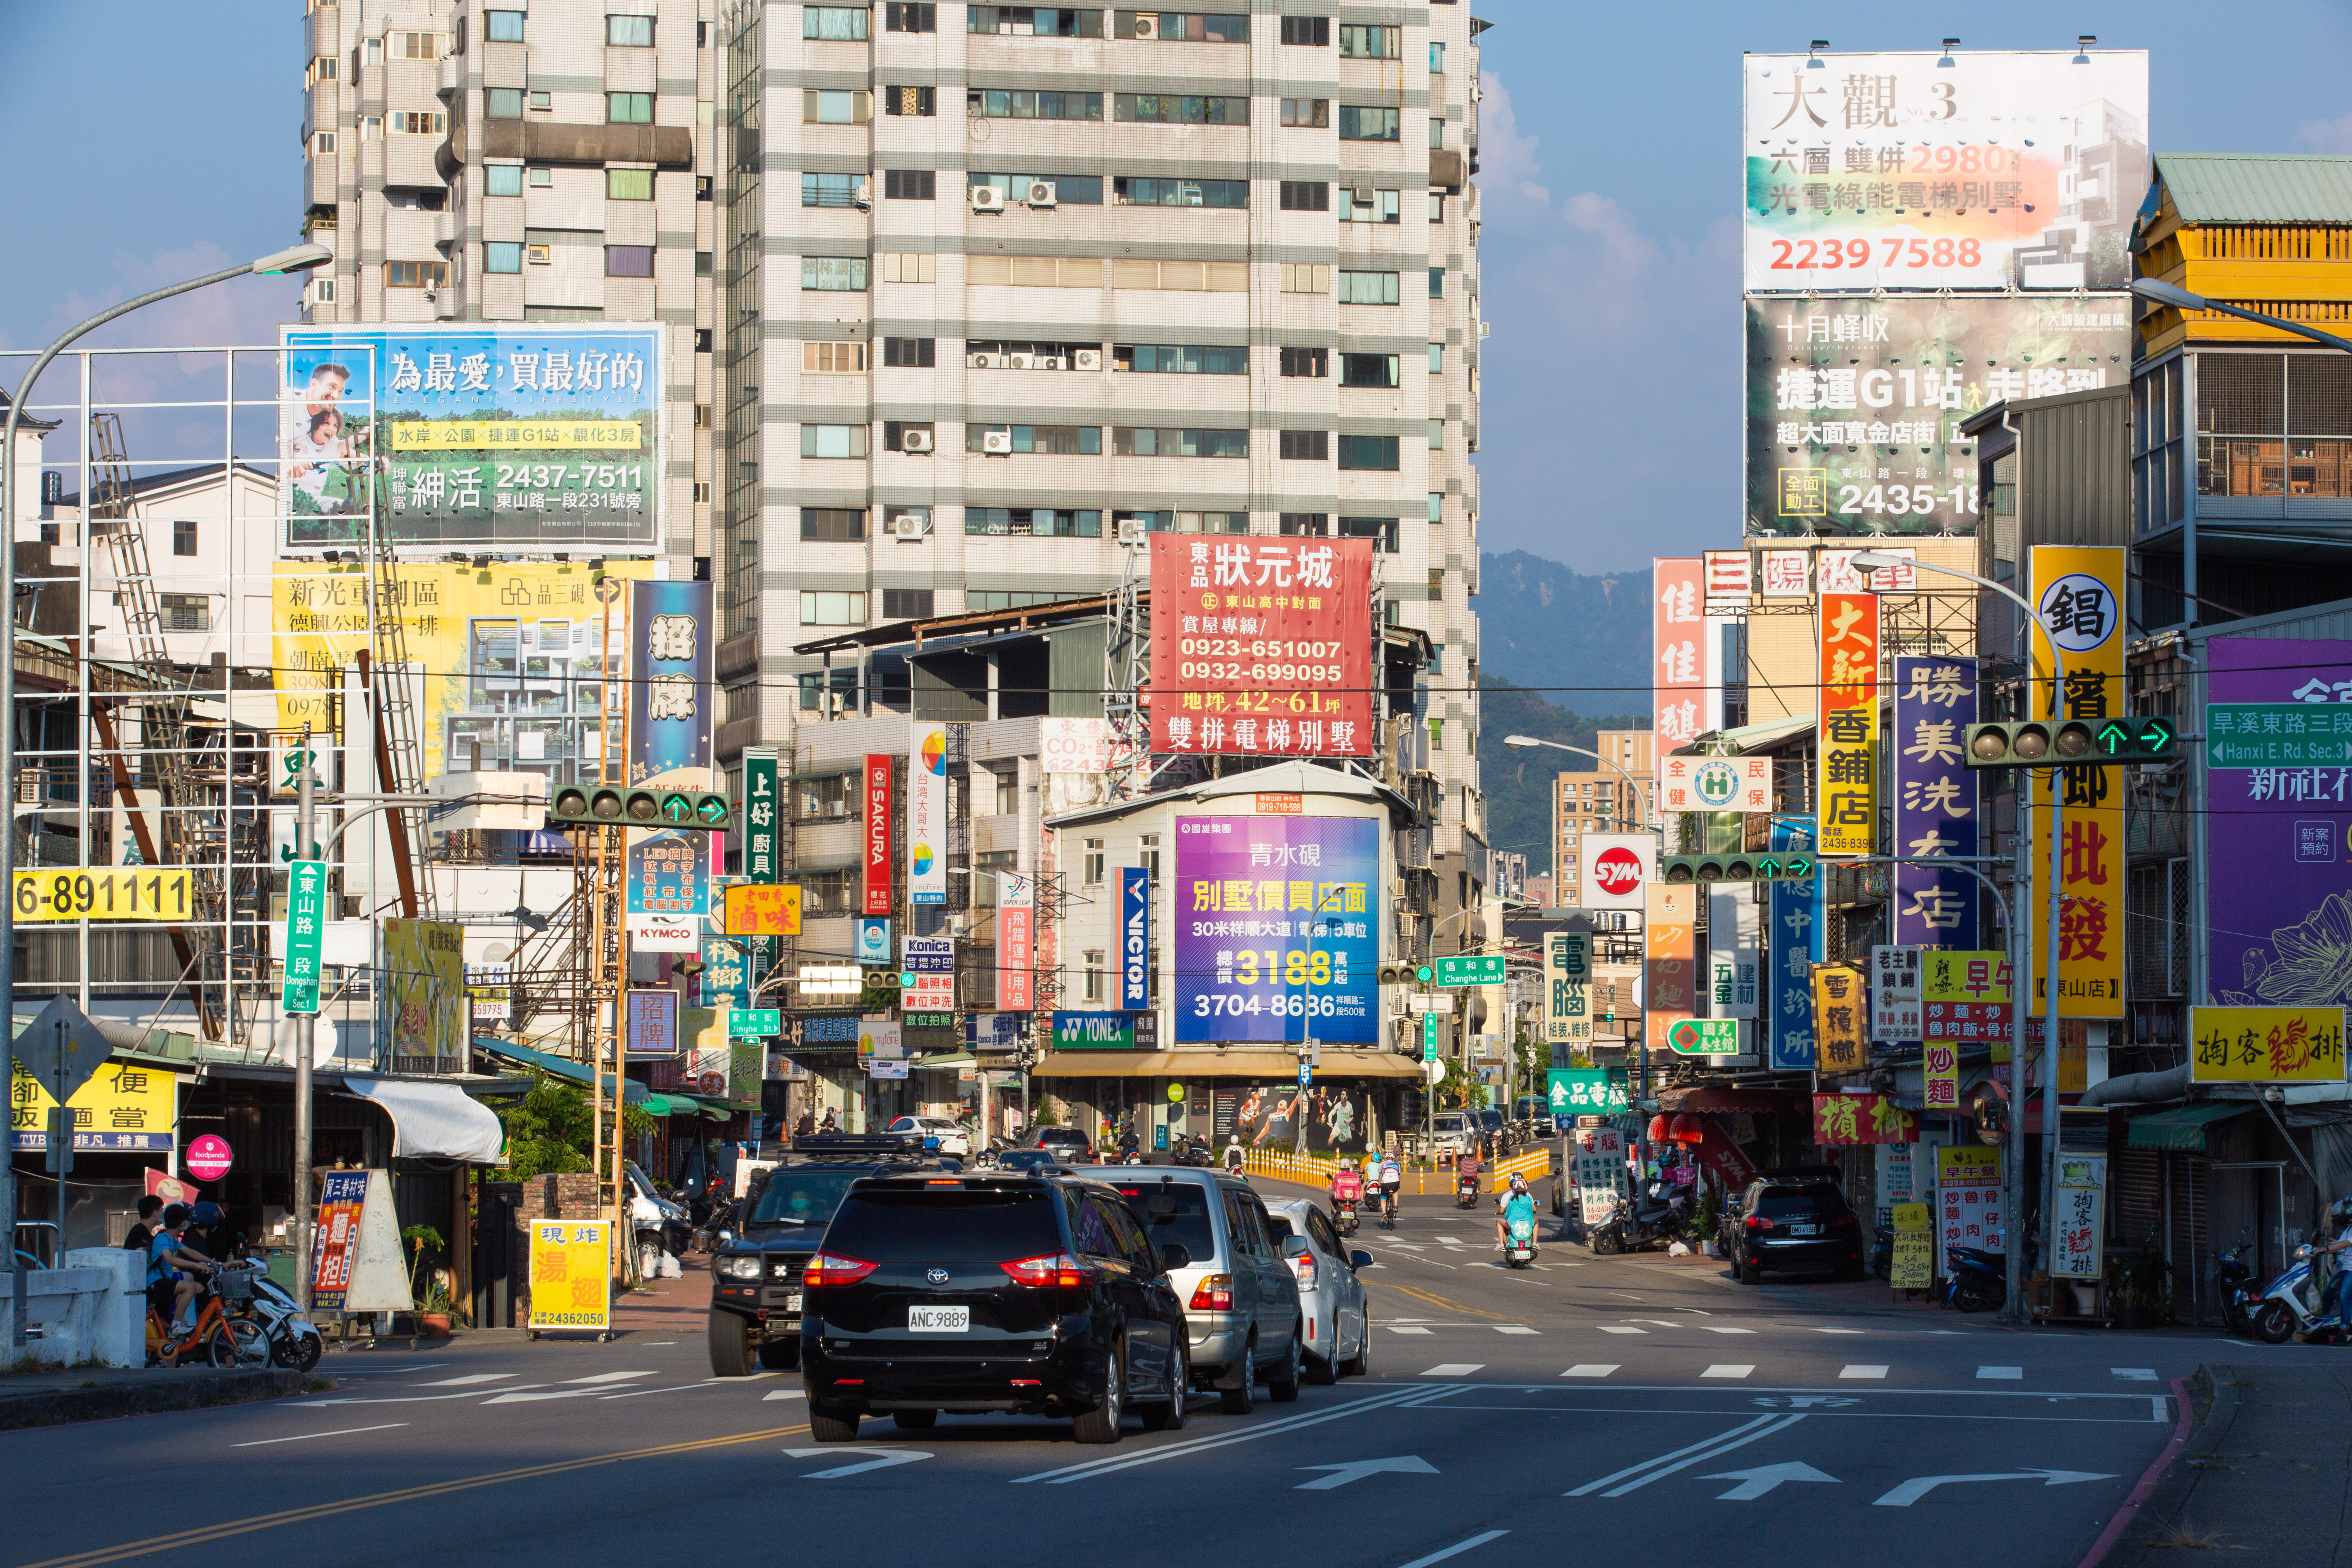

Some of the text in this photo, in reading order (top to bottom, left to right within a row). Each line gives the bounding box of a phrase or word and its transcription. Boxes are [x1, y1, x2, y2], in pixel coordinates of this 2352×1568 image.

[1771, 73, 1957, 130] 大觀 NO. 3
[1770, 146, 1830, 175] 六層
[1844, 146, 1905, 175] 雙併
[1911, 145, 2006, 174] 2980
[1770, 181, 2023, 211] 光電綠能電梯別墅
[1771, 238, 1982, 270] 2239 7588
[1776, 314, 1889, 343] 十月蜂收
[2048, 314, 2124, 326] 大城營建機構
[1777, 368, 1962, 410] 捷運G1站
[497, 465, 642, 488] 2437-7511
[1785, 475, 1819, 491] 全面
[393, 467, 407, 510] 坤聯富
[497, 492, 642, 509] 東山路一段231號旁
[1785, 493, 1819, 510] 動工
[1190, 541, 1208, 588] 東品
[1214, 543, 1333, 588] 狀元城
[538, 583, 585, 605] 品三硯
[1226, 595, 1321, 610] 東山高中對面
[1181, 639, 1341, 658] 0923-651007
[649, 614, 697, 721] 招牌
[1181, 662, 1341, 681] 0932-699095
[2213, 711, 2352, 735] 旱溪東路三段
[1167, 717, 1355, 751] 雙拼電梯別墅
[2226, 742, 2343, 760] Hanxi E. Rd. Sec.3
[1695, 782, 1707, 802] NATIONAL
[1724, 782, 1738, 803] INSURANCE
[1257, 802, 1301, 812] 0919-718-588
[872, 790, 884, 865] SAKURA
[1192, 823, 1231, 834] 國雄集團
[1823, 827, 1842, 836] 電話
[2301, 827, 2329, 841] 新案
[644, 849, 694, 860] LED招牌
[1249, 842, 1321, 867] 青水硯
[2301, 842, 2329, 856] 預約
[1594, 862, 1643, 886] SYM
[17, 875, 185, 914] 6-891111
[644, 887, 694, 898] 紅布條
[745, 889, 783, 902] 老田香
[1193, 880, 1366, 913] 別墅價買店面
[644, 900, 694, 911] 電腦割字
[294, 876, 316, 975] 東山路一段
[388, 921, 399, 933] KIRIN
[732, 905, 795, 933] 滷味
[640, 929, 690, 938] KYMCO
[1192, 921, 1367, 938] 30米祥順大道 電梯 5車位
[909, 939, 950, 952] Konica
[1012, 912, 1025, 1006] 飛躍運動用品
[1128, 919, 1144, 999] VICTOR
[1216, 950, 1348, 986] 總價 3188 萬起
[1445, 960, 1496, 971] 倡和巷
[1879, 950, 1918, 969] 老主顧
[286, 975, 318, 987] Dongshan
[1445, 975, 1477, 984] Changhe
[1551, 935, 1586, 1018] 電腦
[1715, 964, 1732, 1004] 五金
[1737, 964, 1755, 1004] 建材
[296, 988, 307, 997] Rd.
[906, 996, 951, 1007] 數位沖洗
[1336, 996, 1365, 1004] 祥順路二
[293, 999, 310, 1009] Sec.1
[1336, 1007, 1365, 1017] 段500號
[640, 996, 664, 1047] 招牌
[732, 1013, 772, 1022] 景和街
[993, 1016, 1013, 1032] 柯尼卡
[1138, 1017, 1153, 1030] 飛躍
[1085, 1018, 1121, 1041] YONEX
[1703, 1022, 1732, 1036] 國光
[1878, 1027, 1918, 1038] 0800-36-36-88
[874, 1033, 898, 1047] myfone
[1136, 1034, 1154, 1043] 運動用品
[1699, 1037, 1734, 1051] 養生館
[702, 1077, 722, 1088] 早餐
[1927, 1047, 1956, 1105] 炒麵
[110, 1071, 149, 1128] 便當
[1549, 1080, 1627, 1107] 金品電腦
[1819, 1095, 1915, 1141] 檳榔
[1581, 1133, 1618, 1154] 電腦
[1582, 1157, 1622, 1168] 維修組裝
[1944, 1166, 1997, 1177] 早午餐
[1583, 1169, 1623, 1180] 週邊設備
[541, 1227, 600, 1245] 現炸
[549, 1312, 604, 1325] 24362050
